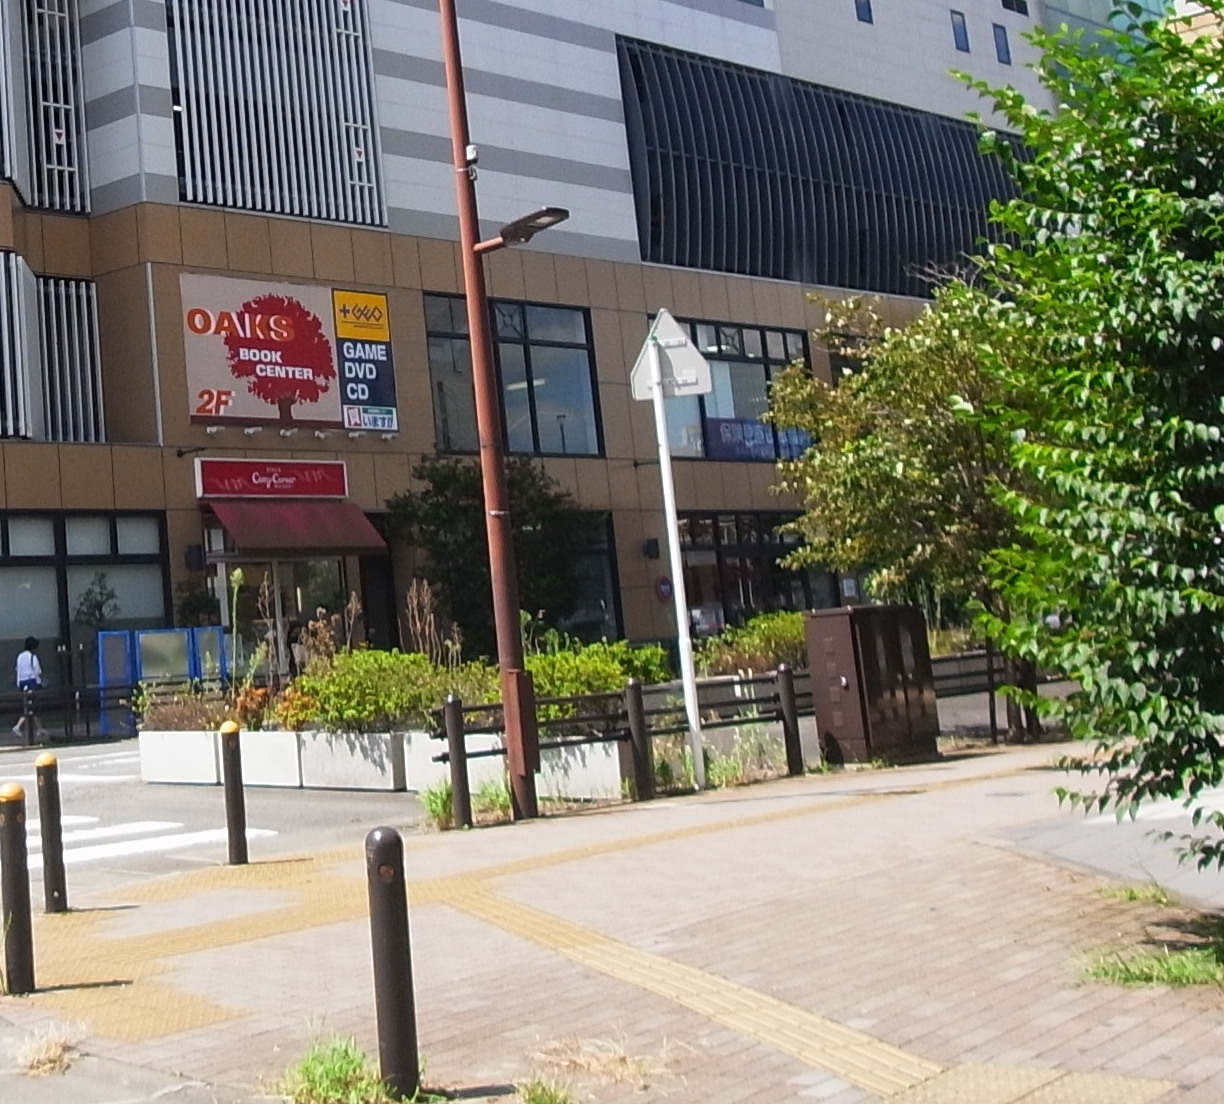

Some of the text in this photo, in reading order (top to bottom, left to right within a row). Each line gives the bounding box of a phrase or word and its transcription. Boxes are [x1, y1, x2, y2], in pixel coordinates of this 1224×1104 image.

[186, 308, 297, 343] OAKS
[238, 347, 283, 364] BOOK
[343, 341, 388, 361] GAME
[255, 363, 314, 381] CENTER
[344, 361, 377, 380] DVD
[346, 382, 370, 401] CD
[195, 388, 237, 416] 2F
